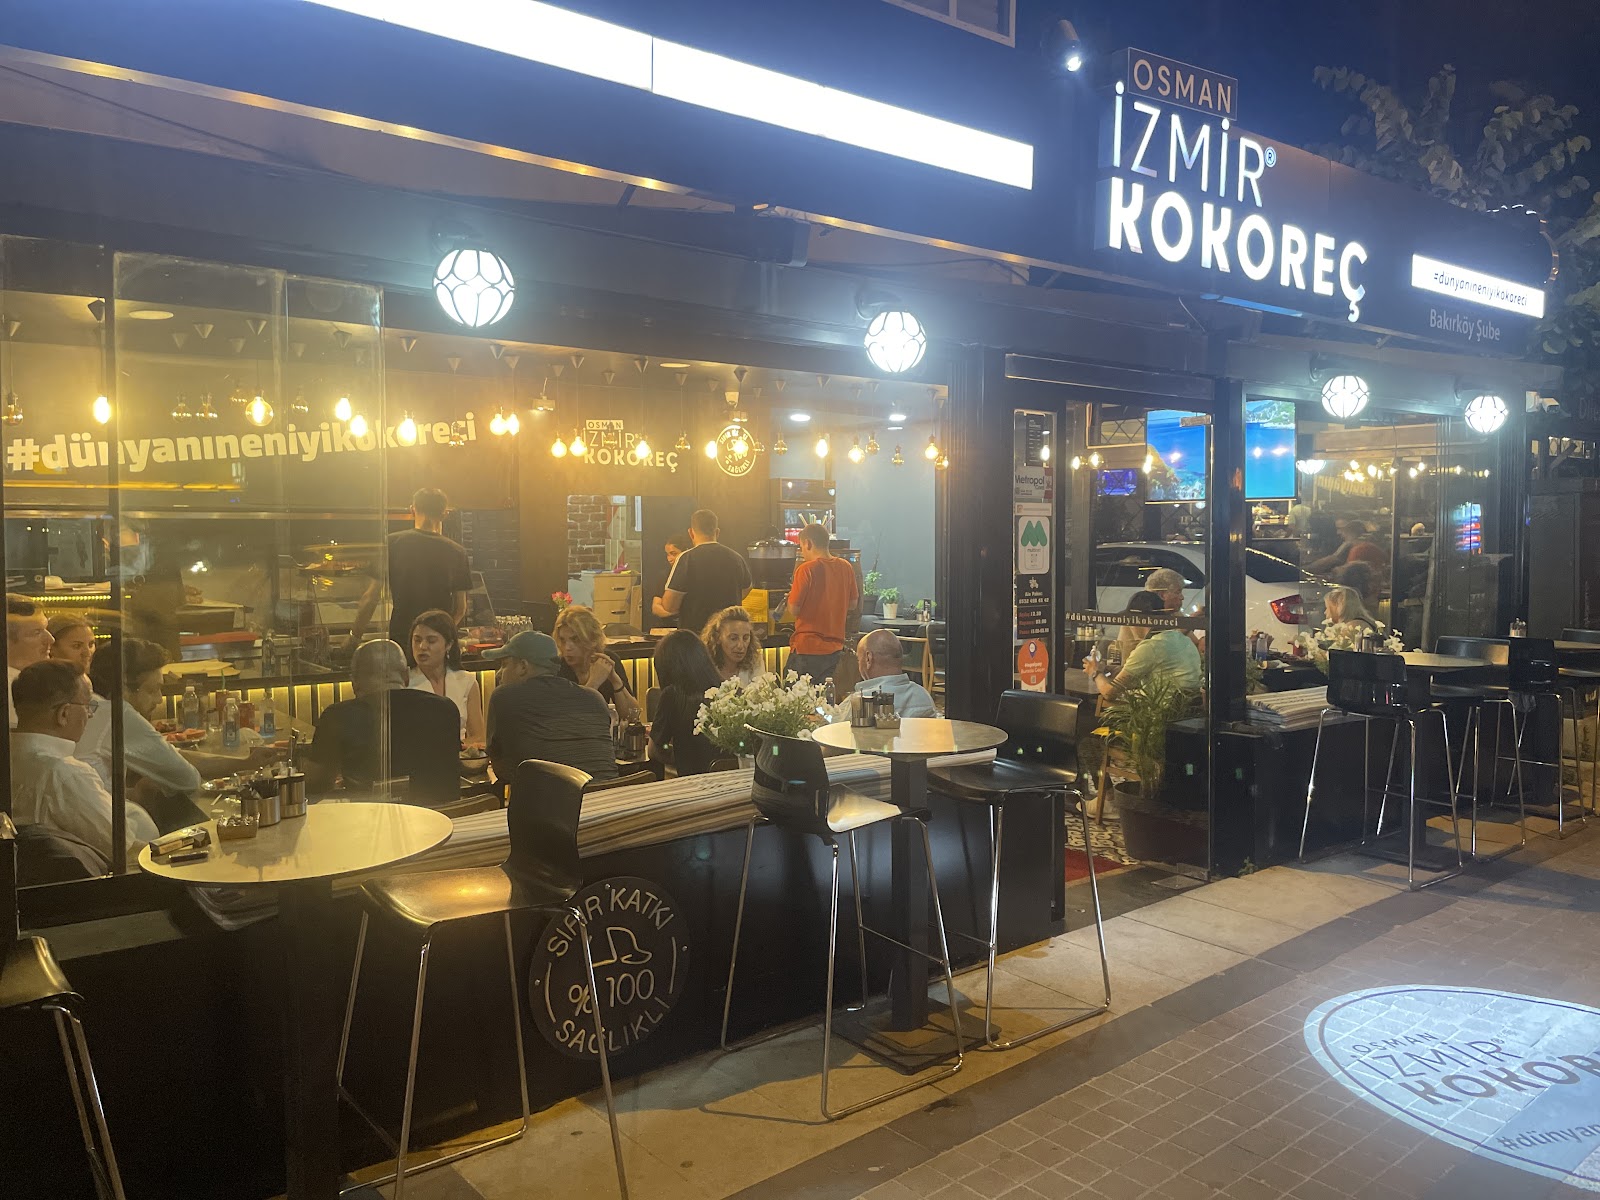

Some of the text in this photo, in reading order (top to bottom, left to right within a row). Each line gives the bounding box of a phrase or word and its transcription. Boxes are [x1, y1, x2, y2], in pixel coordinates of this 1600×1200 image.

[1133, 58, 1232, 115] OSMAN
[1112, 81, 1265, 207] İZMİR
[1109, 176, 1369, 323] KOKOREÇ
[1430, 308, 1501, 342] Bakırköy Şube
[588, 421, 622, 429] OSMN
[609, 887, 675, 930] KATKI
[1351, 1032, 1439, 1054] OSMAN
[1398, 1049, 1600, 1106] KOKOR
